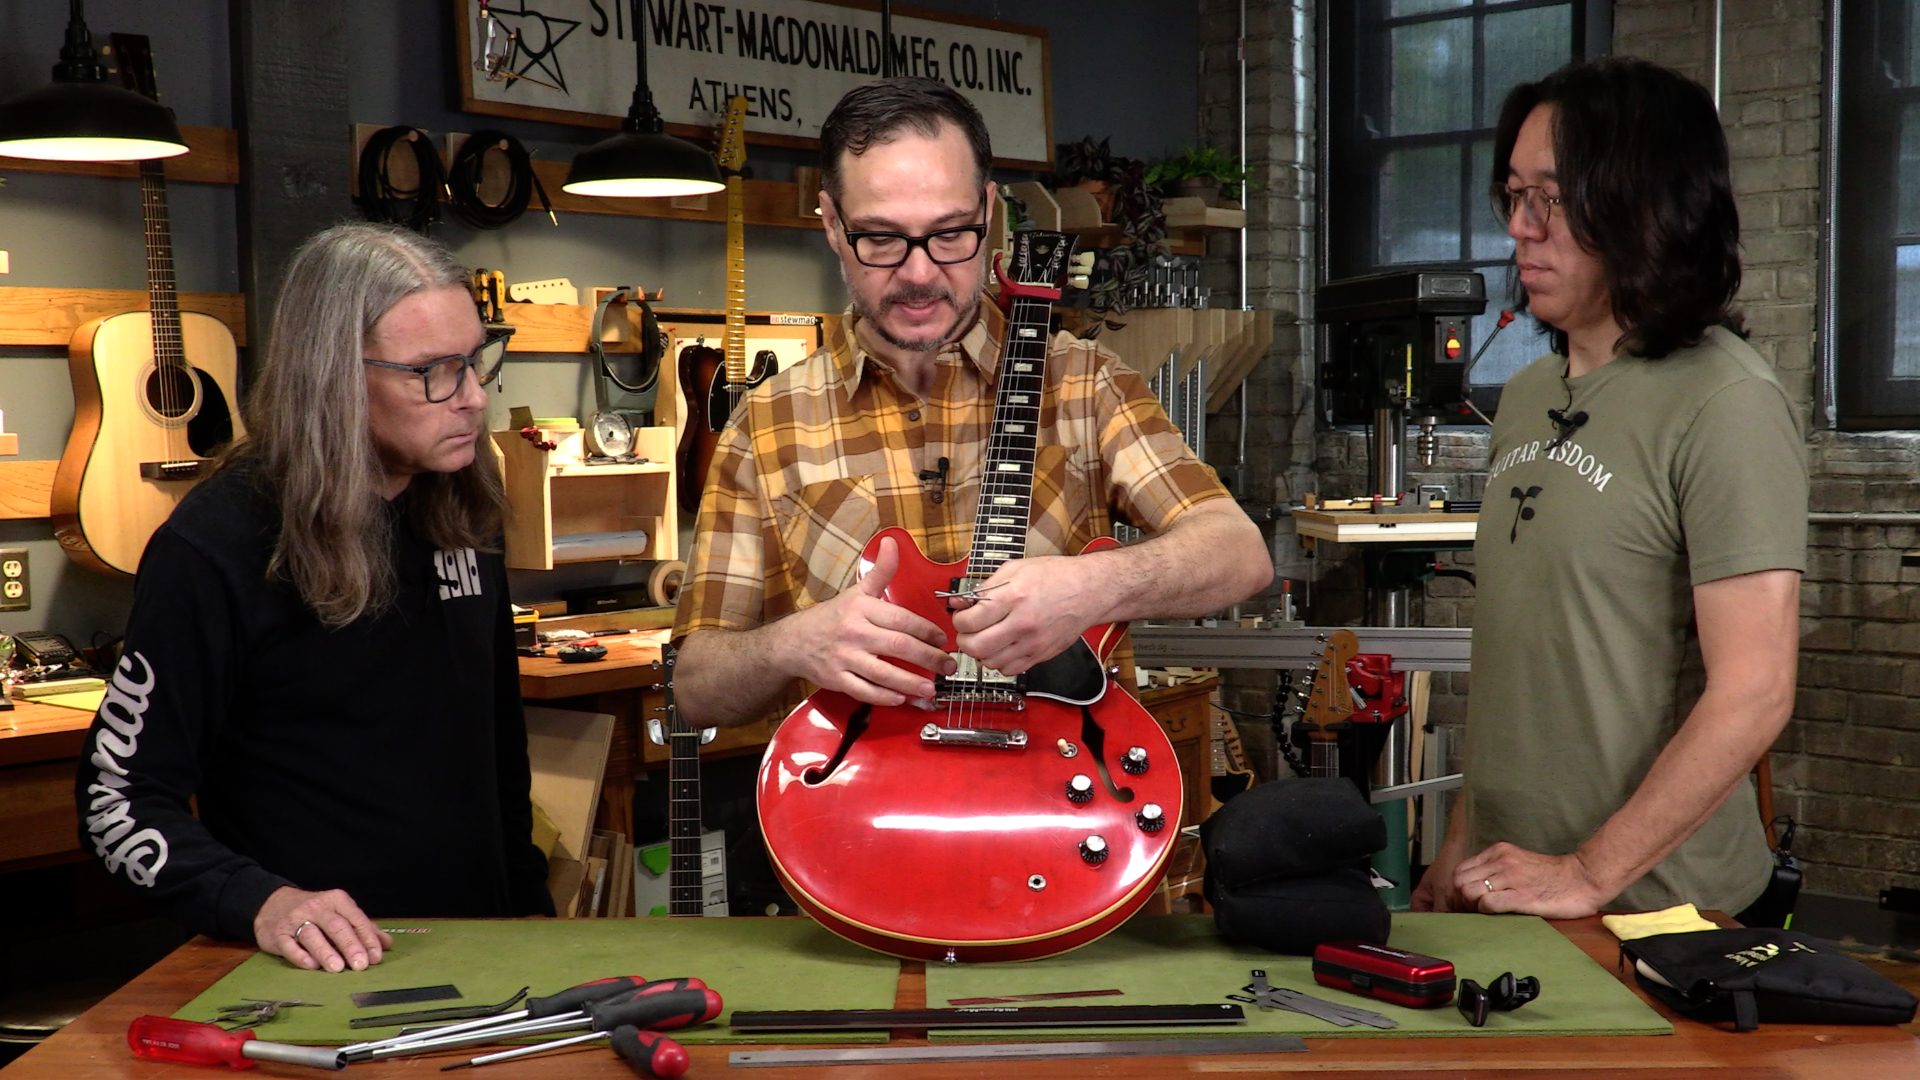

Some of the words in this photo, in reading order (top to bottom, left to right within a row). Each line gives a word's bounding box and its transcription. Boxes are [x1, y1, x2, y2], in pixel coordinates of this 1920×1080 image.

[590, 0, 881, 76] STWART-MACDONALD
[949, 42, 984, 90] CO.
[987, 48, 1032, 96] INC.
[780, 315, 814, 325] stewmac
